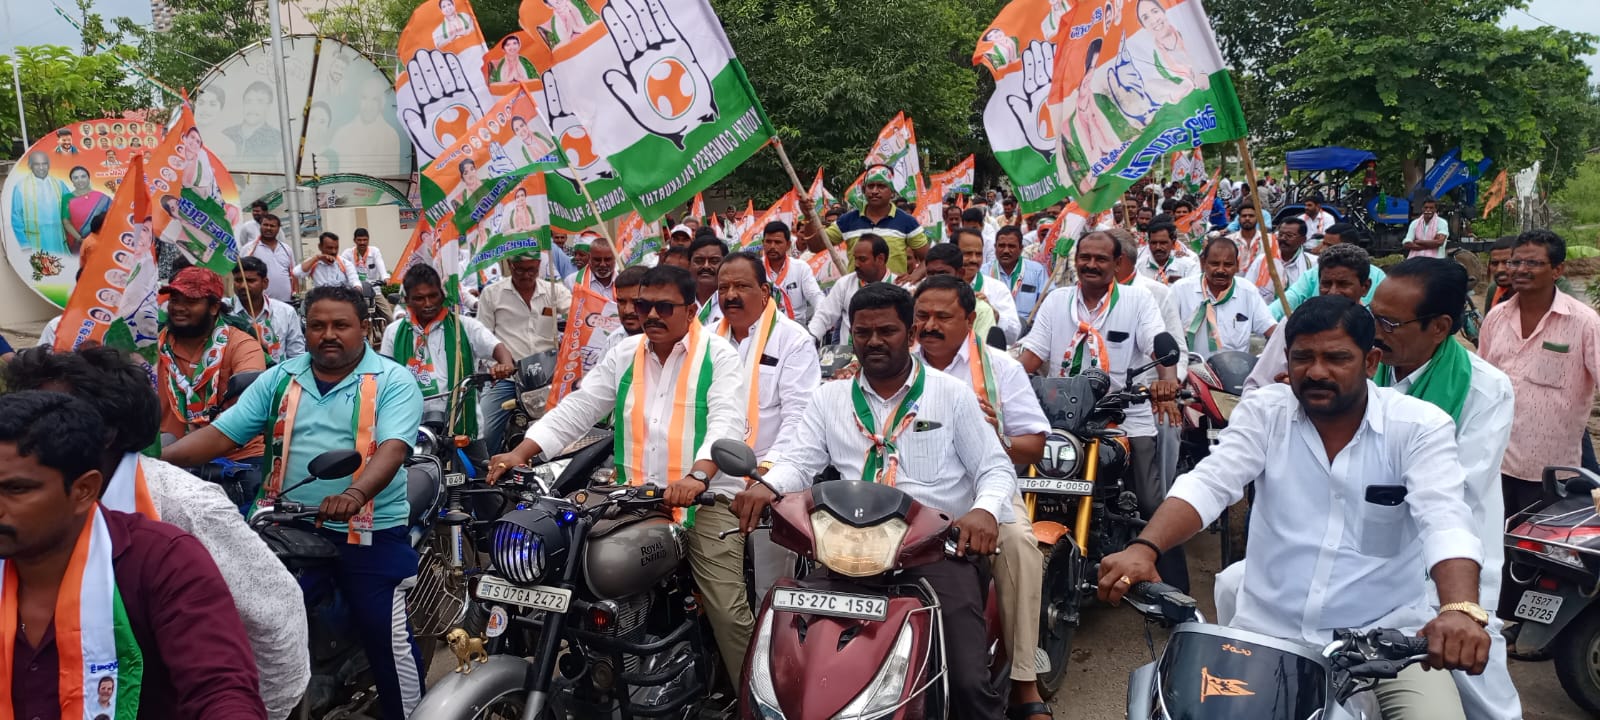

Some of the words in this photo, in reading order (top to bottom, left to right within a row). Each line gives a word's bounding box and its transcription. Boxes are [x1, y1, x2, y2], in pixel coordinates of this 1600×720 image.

[640, 541, 664, 556] ROYAL
[533, 591, 564, 609] 2472
[847, 597, 883, 615] 1594
[1517, 603, 1527, 615] G
[1527, 606, 1554, 621] 5725
